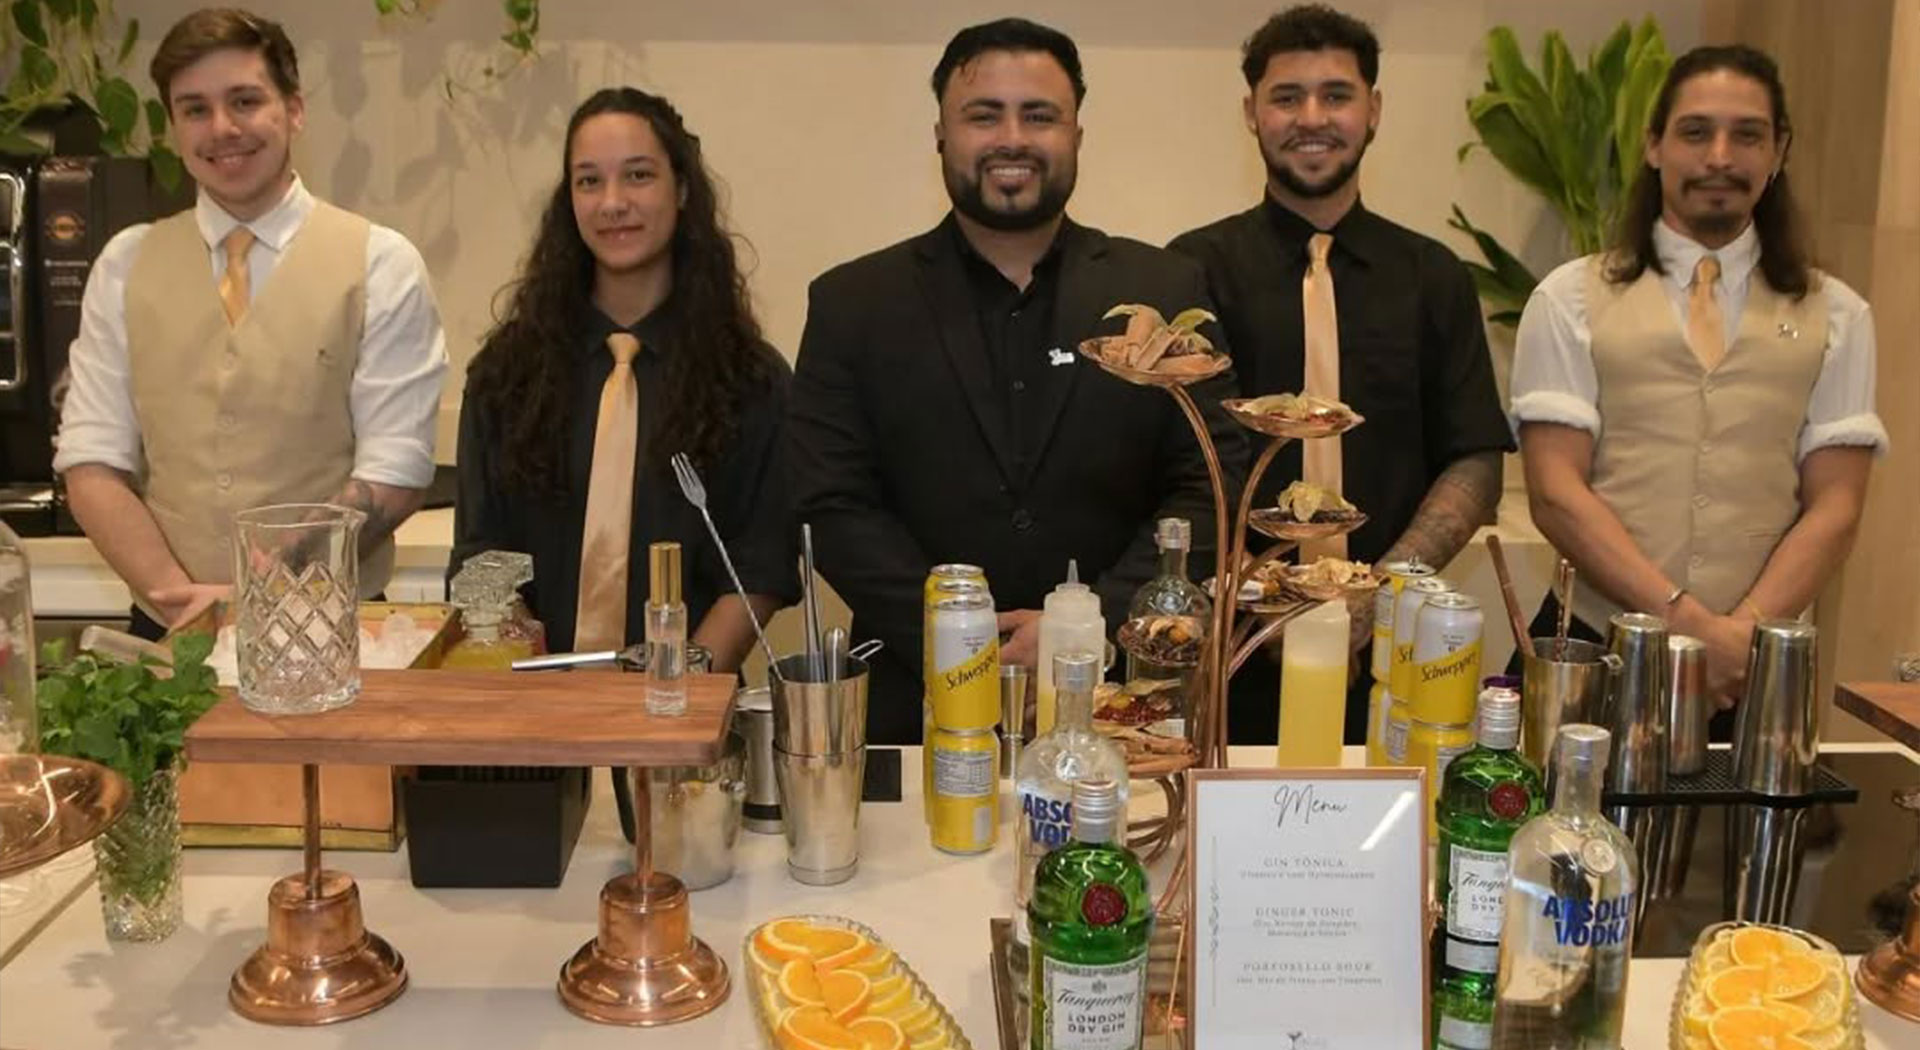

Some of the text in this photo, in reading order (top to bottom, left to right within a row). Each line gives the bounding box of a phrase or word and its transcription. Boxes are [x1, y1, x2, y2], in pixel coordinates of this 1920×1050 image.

[1022, 792, 1072, 824] ABSO
[1273, 783, 1348, 828] Menu
[1263, 857, 1288, 868] GIN
[1255, 906, 1355, 917] GINGER TONIC
[1542, 893, 1633, 922] ABSOLU
[1067, 1011, 1126, 1024] LONDON
[1067, 1021, 1125, 1035] DRY GIN
